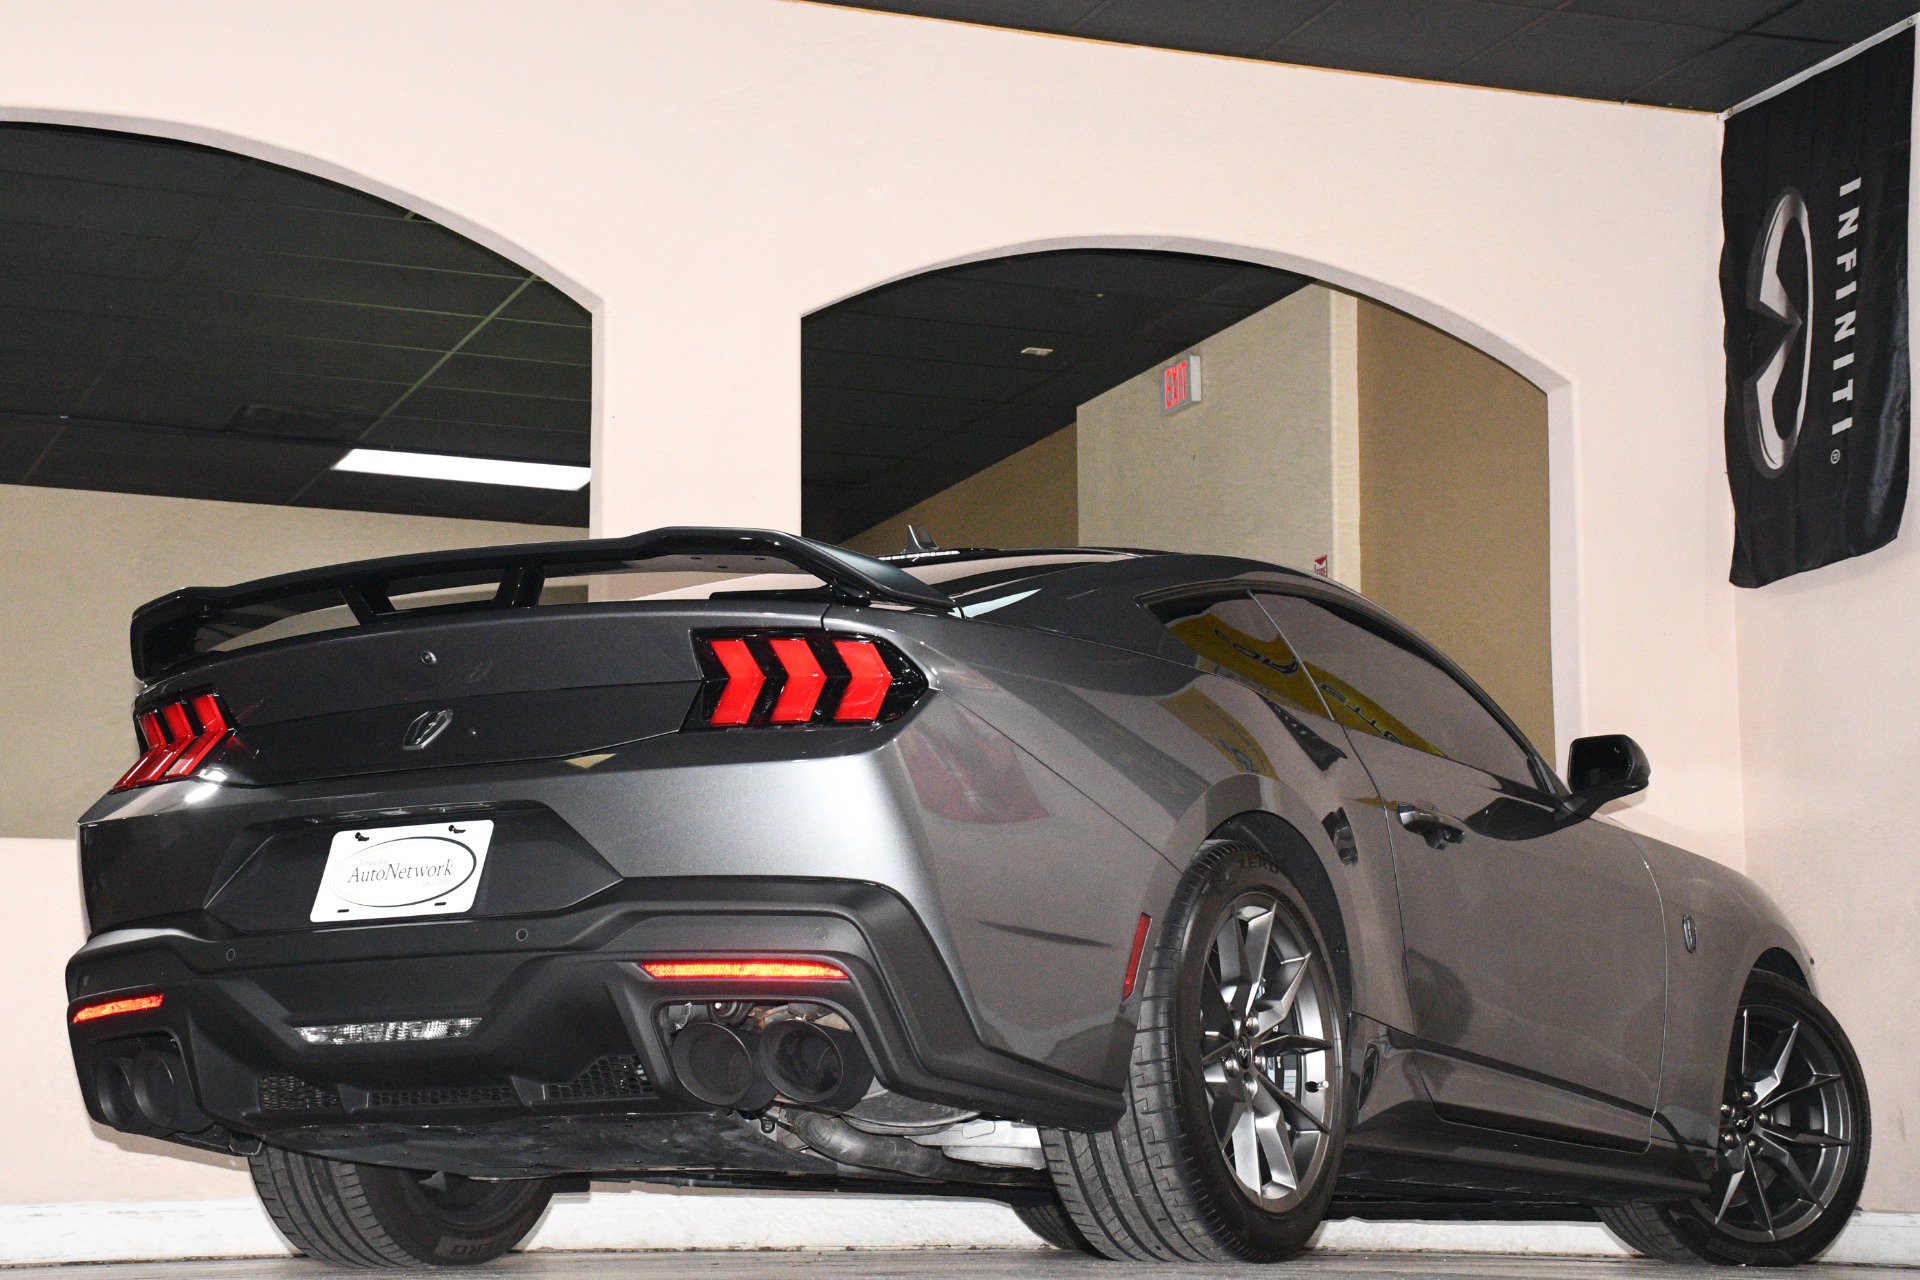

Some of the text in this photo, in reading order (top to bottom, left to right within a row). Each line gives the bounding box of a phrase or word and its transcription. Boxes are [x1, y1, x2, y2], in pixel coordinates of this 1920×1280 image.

[1831, 176, 1862, 436] INFINITI
[1165, 360, 1187, 408] EXIT
[347, 859, 453, 883] AutoNetwork
